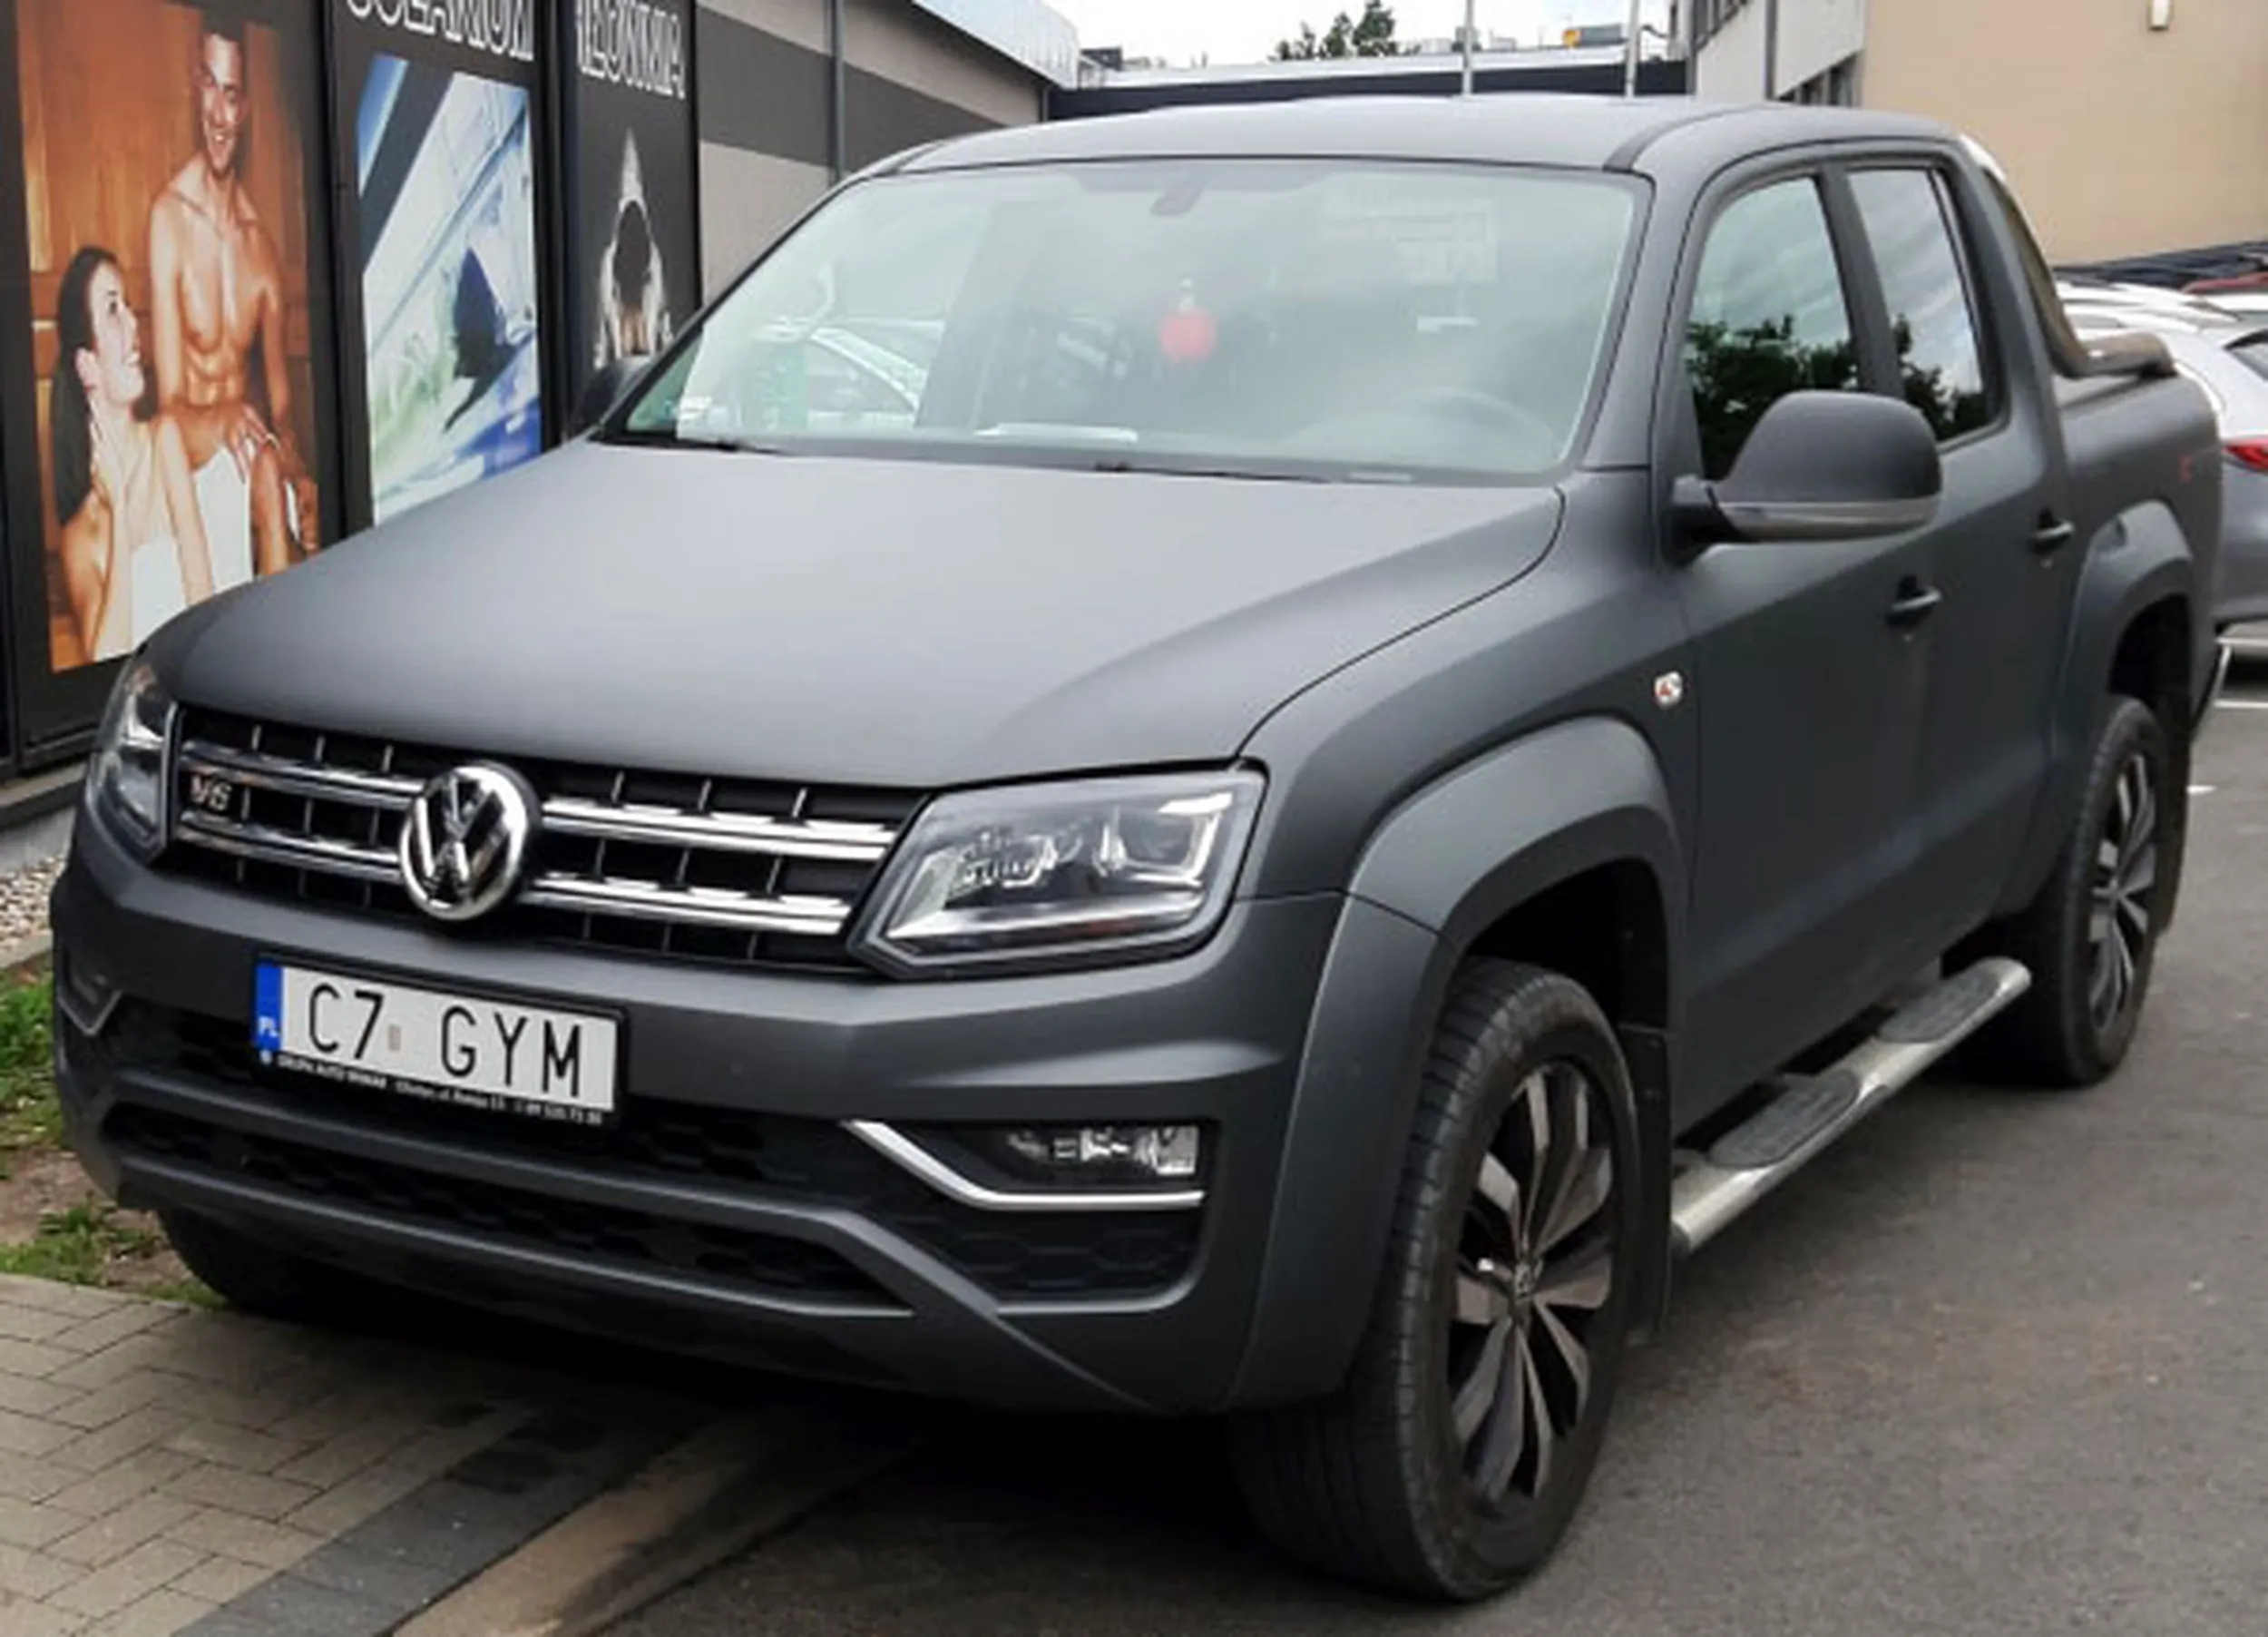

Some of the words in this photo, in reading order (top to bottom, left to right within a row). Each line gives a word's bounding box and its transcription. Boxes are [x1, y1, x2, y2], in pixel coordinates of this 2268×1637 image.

[191, 775, 232, 810] V6
[308, 982, 384, 1060] C7
[440, 1005, 581, 1098] GYM
